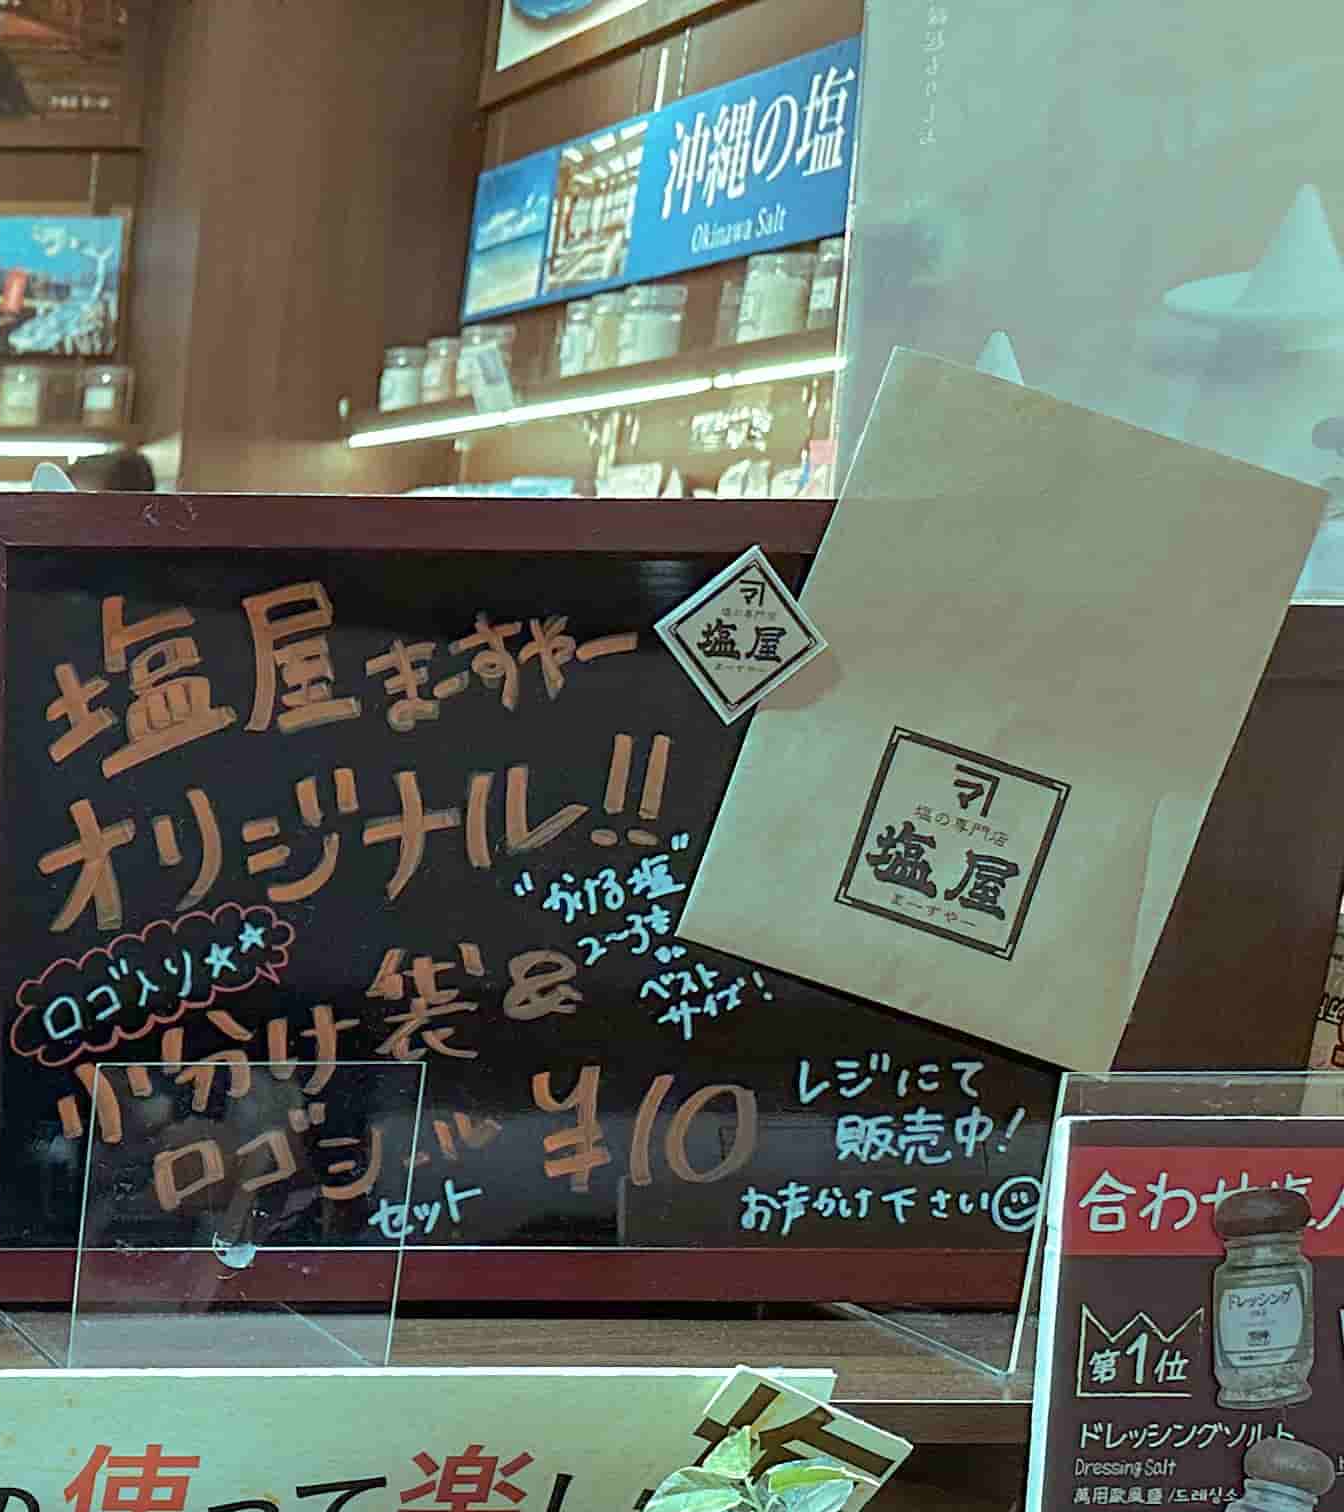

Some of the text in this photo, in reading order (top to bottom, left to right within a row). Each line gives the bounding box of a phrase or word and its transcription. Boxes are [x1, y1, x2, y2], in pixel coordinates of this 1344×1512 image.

[662, 65, 855, 220] 沖縄の塩
[691, 203, 786, 253] Okinawa Salt
[697, 618, 786, 663] 塩屋
[864, 821, 1019, 921] 塩屋
[799, 1053, 984, 1104] レジにて
[835, 1107, 1026, 1166] 販売中!
[370, 1180, 483, 1239] セット
[1088, 1333, 1188, 1385] 第1位
